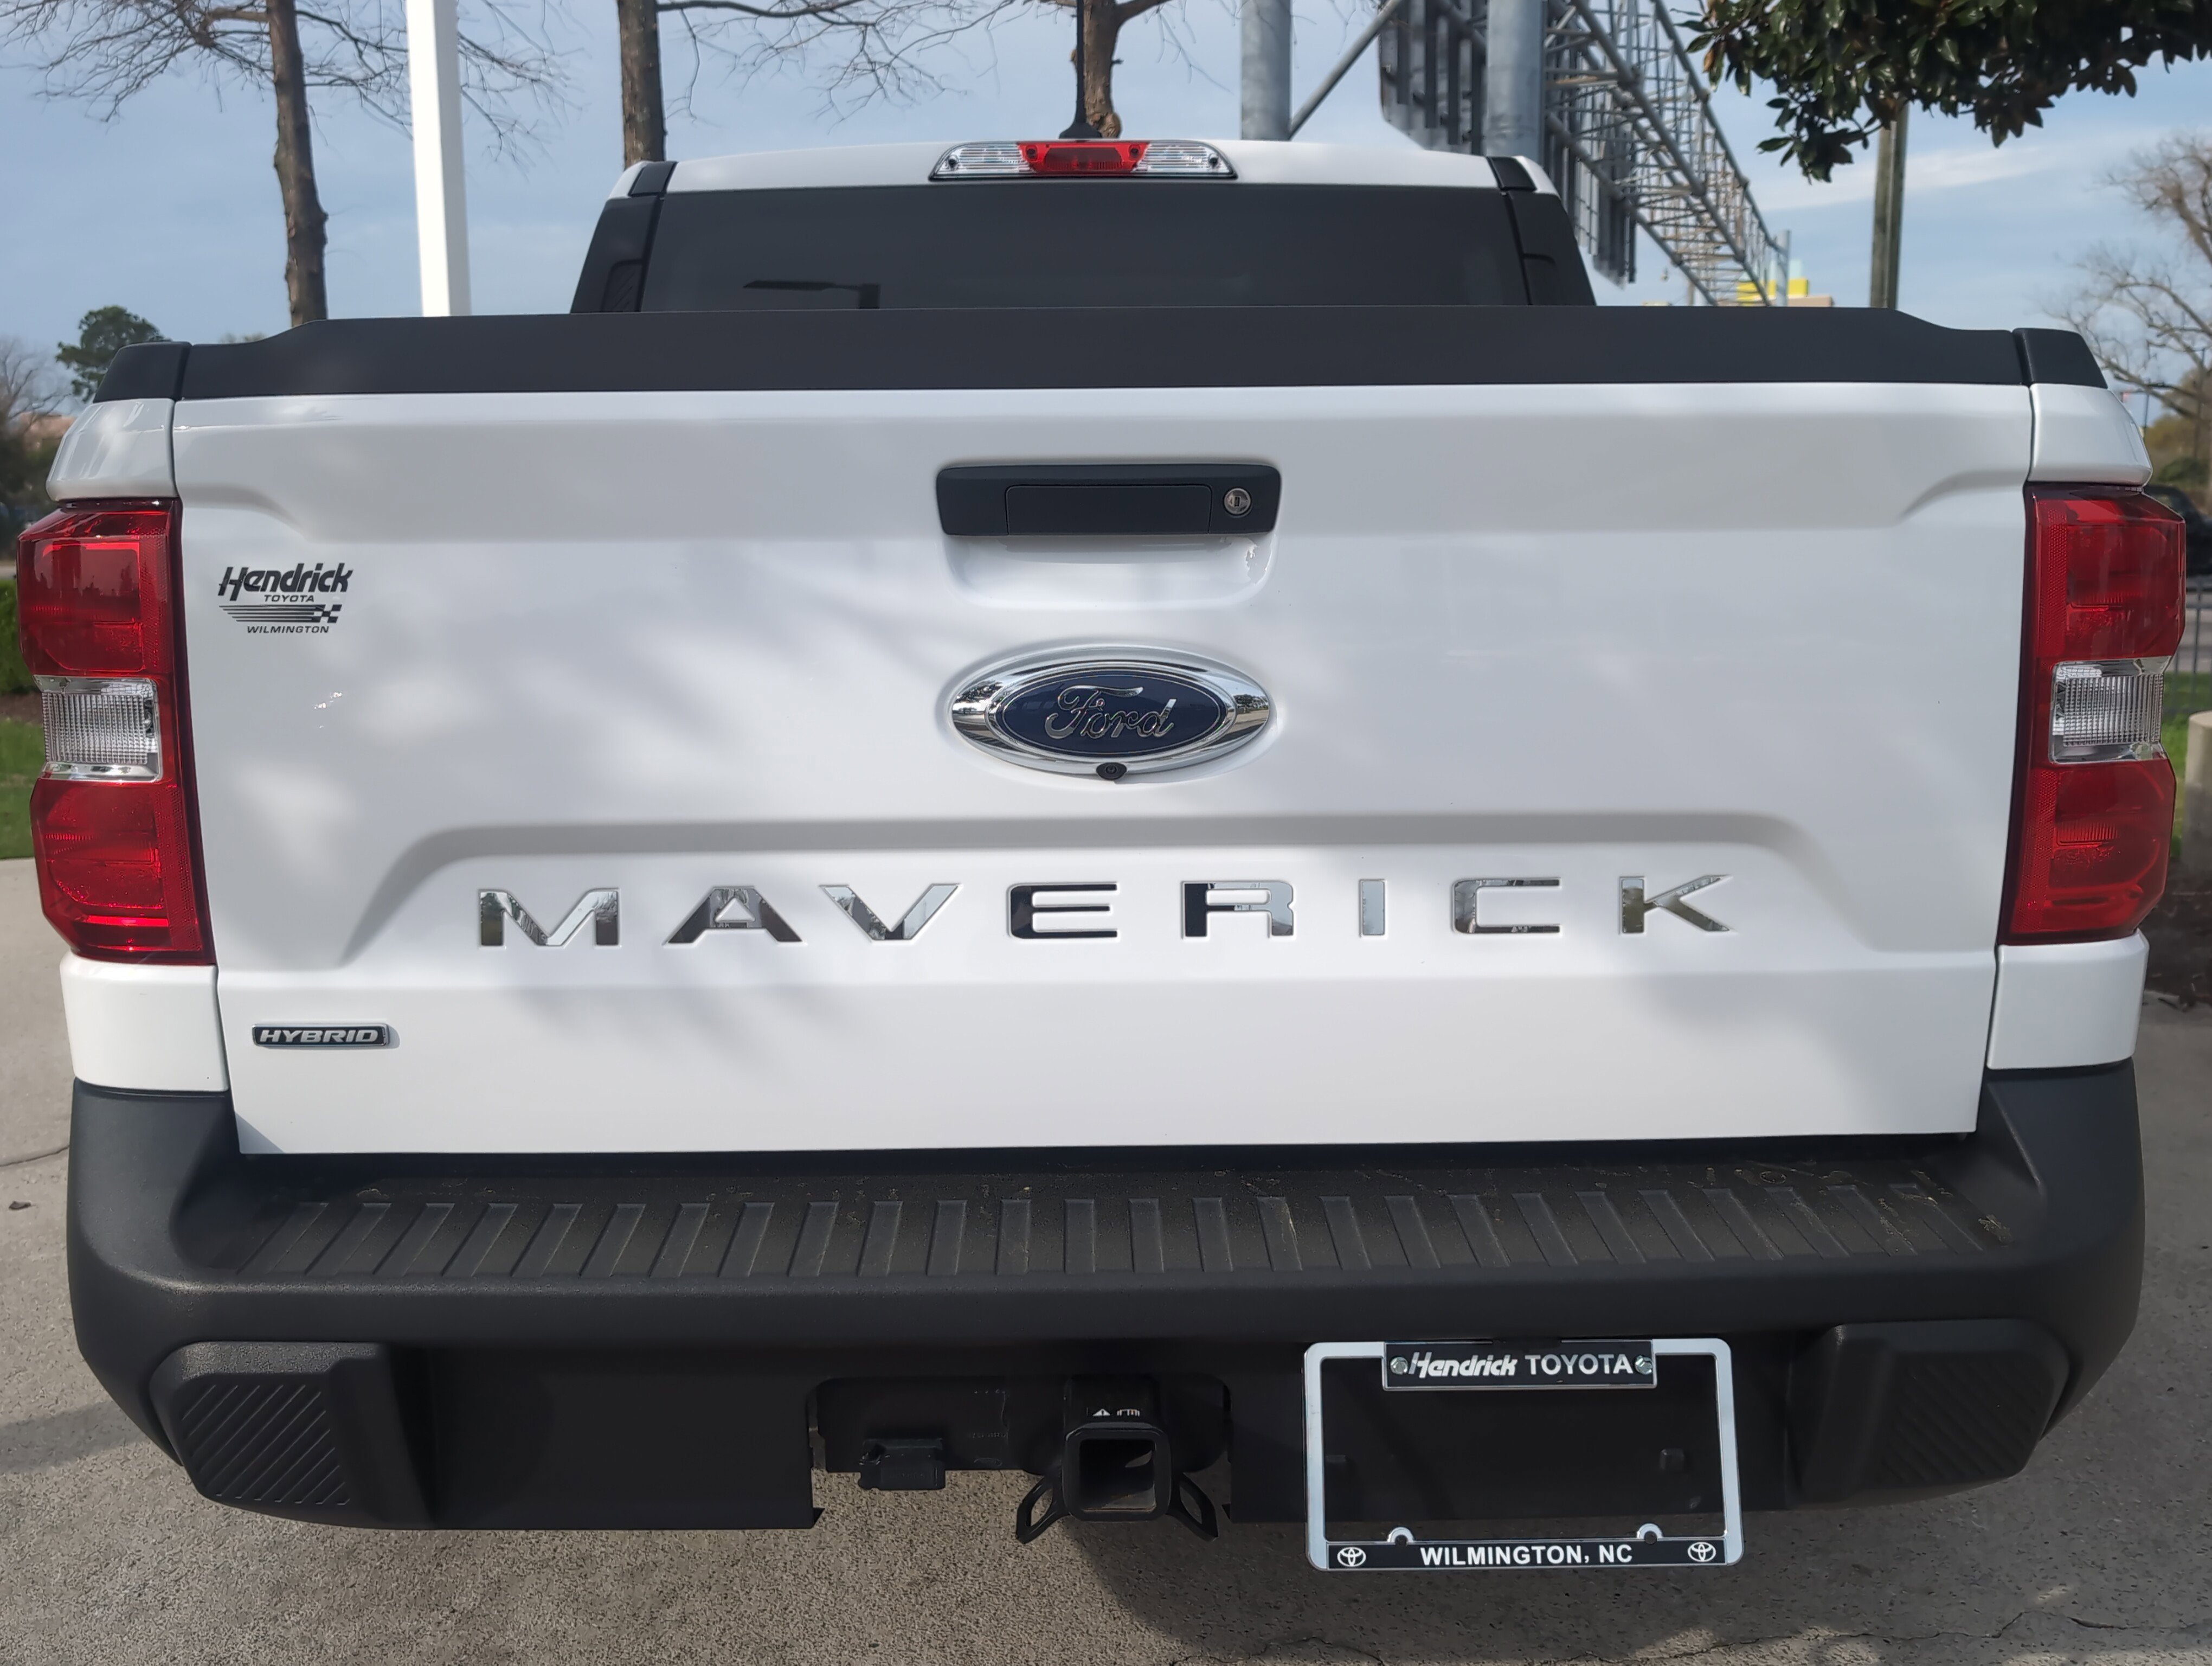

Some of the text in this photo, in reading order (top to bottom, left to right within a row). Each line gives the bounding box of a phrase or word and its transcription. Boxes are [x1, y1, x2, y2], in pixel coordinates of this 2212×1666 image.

[218, 562, 353, 601] Hendrick
[263, 594, 314, 603] TOYOTA
[247, 625, 329, 633] WILMINGTON
[1044, 684, 1175, 740] Ford
[478, 875, 1733, 947] MAVERICK
[260, 1029, 378, 1042] HYBRID
[1409, 1352, 1634, 1379] Hendrick TOYOTA
[1420, 1544, 1632, 1566] WILMINGTON, NC
